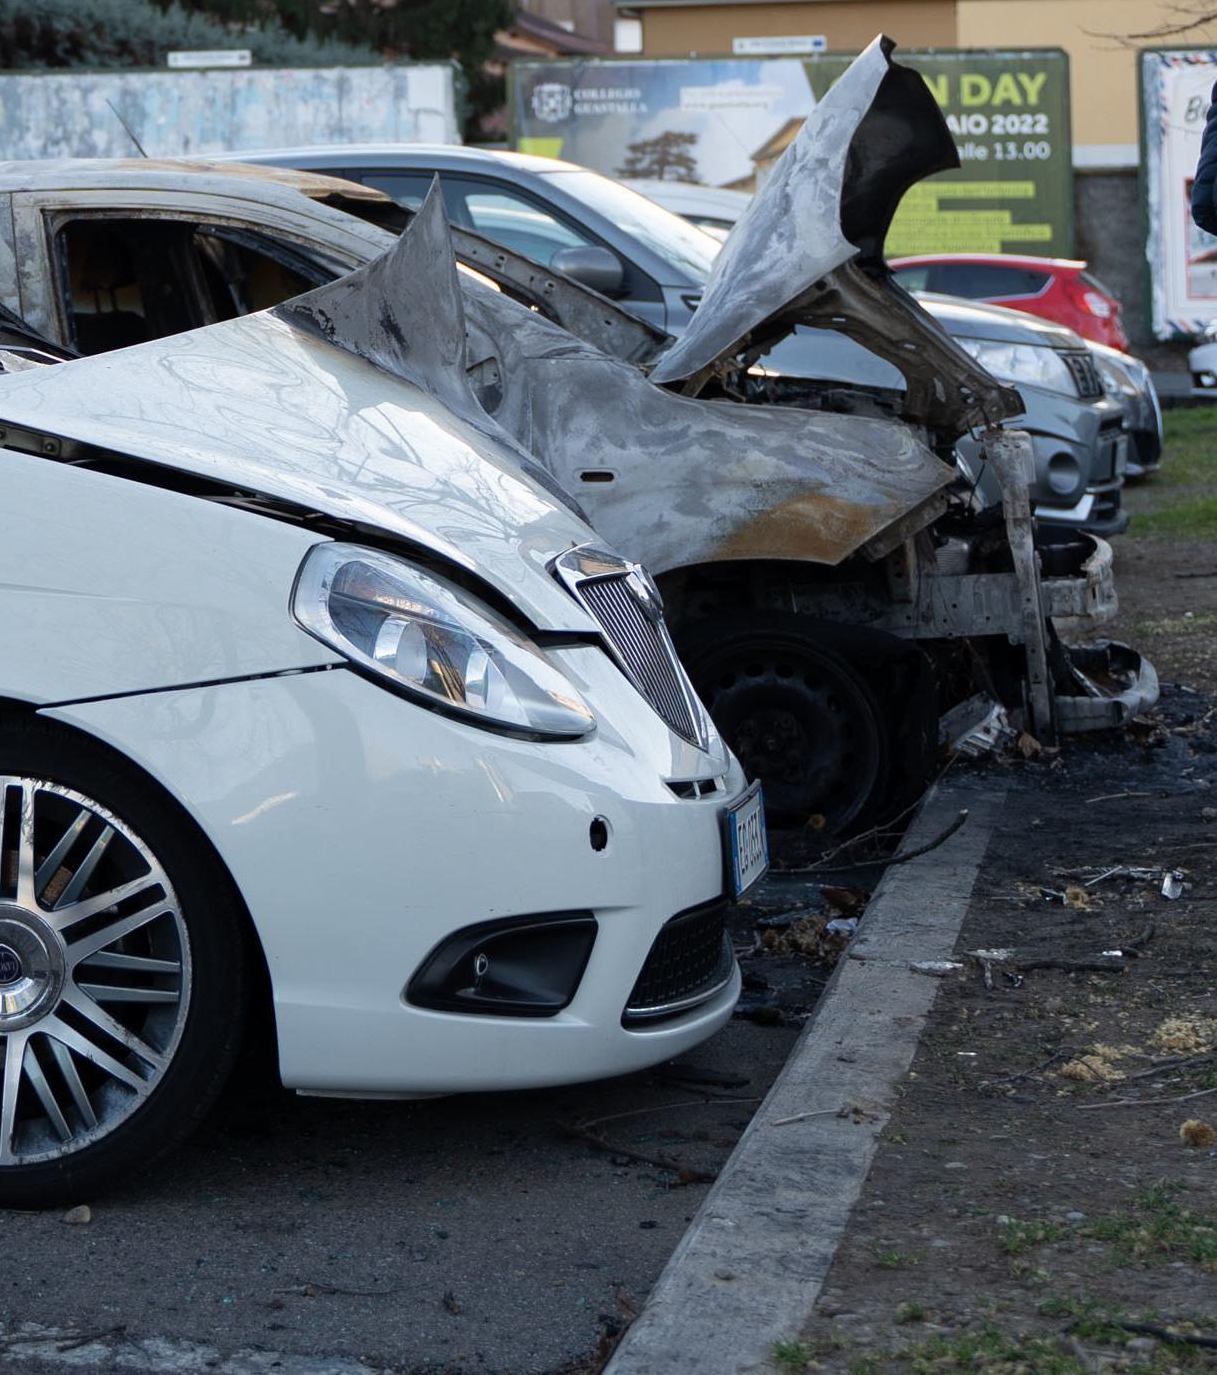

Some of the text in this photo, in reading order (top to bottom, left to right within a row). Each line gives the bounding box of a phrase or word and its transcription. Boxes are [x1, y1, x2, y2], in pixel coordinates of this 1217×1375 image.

[573, 87, 641, 99] COLLEGIO
[960, 73, 1046, 106] DAY
[573, 102, 648, 114] GUASTALLA
[991, 113, 1048, 135] 2022
[994, 141, 1050, 160] 13.00
